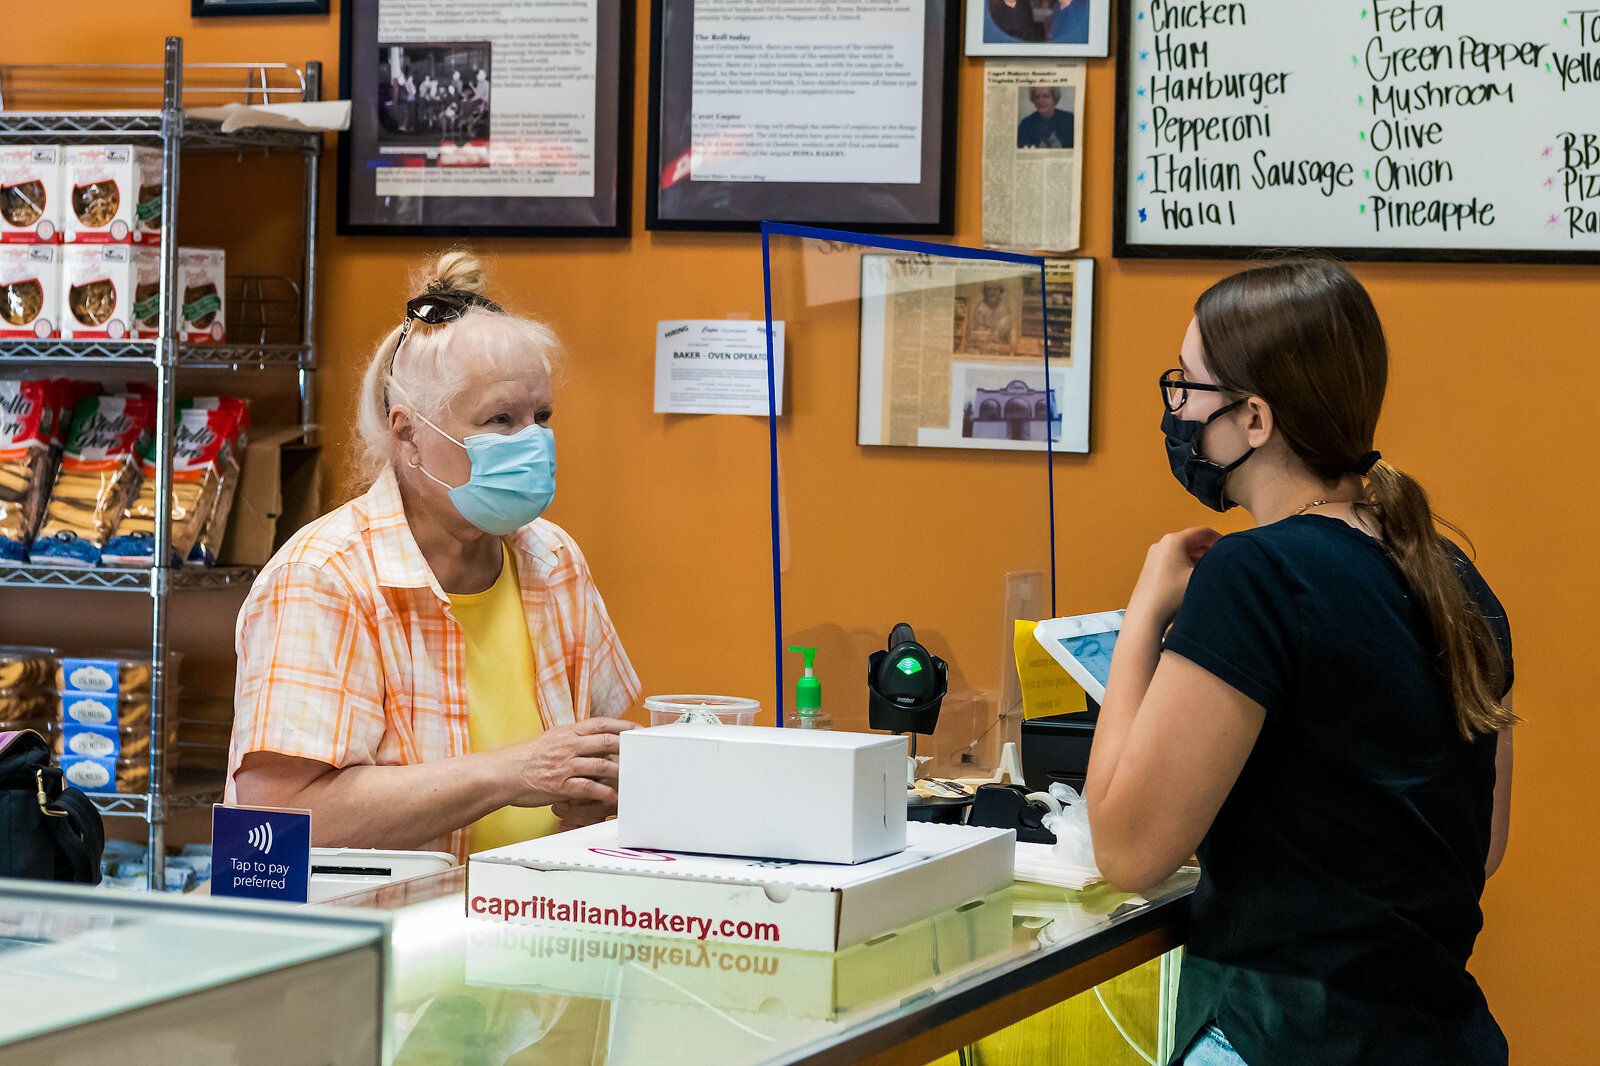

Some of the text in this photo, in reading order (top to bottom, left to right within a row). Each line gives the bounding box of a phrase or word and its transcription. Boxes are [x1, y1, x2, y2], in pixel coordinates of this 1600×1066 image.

[1150, 0, 1246, 32] Chicken
[1372, 0, 1444, 32] Feta
[1366, 36, 1550, 82] Green Pepper
[1372, 81, 1514, 118] Mushroom
[1152, 106, 1270, 152] Pepperoni
[1370, 117, 1442, 152] Olive
[1147, 150, 1354, 196] Italian Sausage
[1375, 156, 1452, 192] Onion
[1162, 199, 1236, 230] Halal
[1368, 196, 1495, 232] Pineapple
[664, 325, 689, 338] HIRING
[733, 352, 767, 360] OPERATO
[230, 858, 290, 877] Tap to pay
[233, 875, 286, 889] preferred
[470, 894, 780, 942] capriitalianbakery.com
